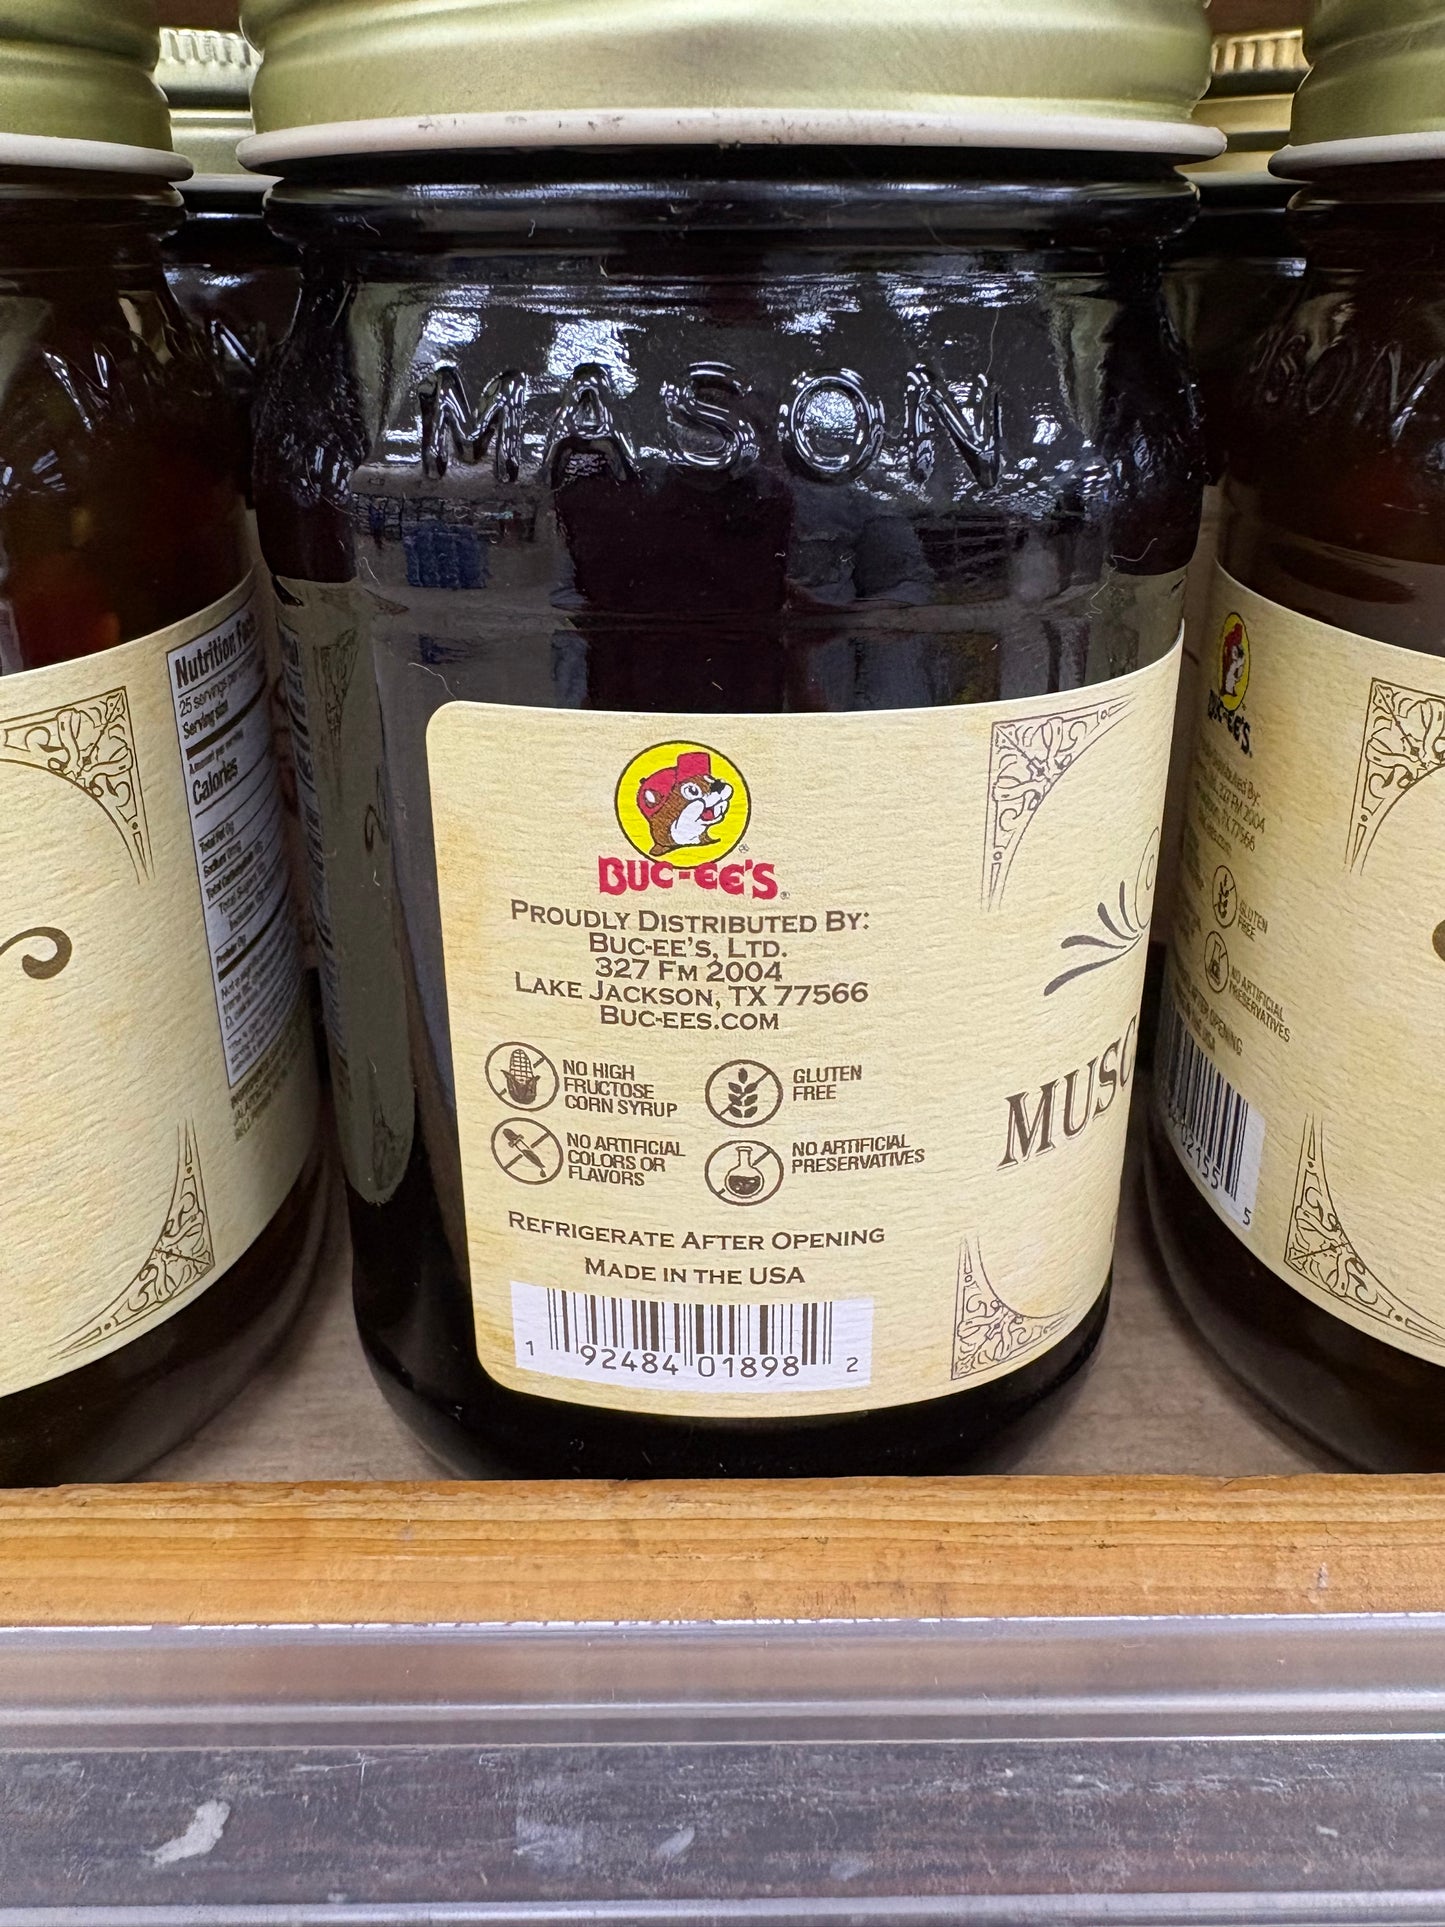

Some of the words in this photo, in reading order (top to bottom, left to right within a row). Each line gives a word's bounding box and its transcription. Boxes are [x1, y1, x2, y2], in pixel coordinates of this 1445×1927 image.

[418, 360, 1004, 489] MASON
[175, 632, 237, 689] Nutrition
[180, 696, 193, 718] 25
[192, 757, 239, 806] Calories
[597, 855, 779, 899] BUC-EE'S
[511, 899, 630, 931] PROUDLY
[638, 909, 817, 933] DISTRIBUTED
[826, 909, 870, 932] BY:
[1239, 900, 1269, 935] GLUTEN
[727, 938, 788, 959] LTD.
[595, 956, 650, 980] 327
[706, 961, 783, 982] 2004
[514, 971, 583, 1000] LAKE
[589, 980, 722, 1010] JACKSON,
[728, 985, 767, 1006] TX
[775, 981, 869, 1006] 77566
[1240, 976, 1285, 1023] ARTIFICIAL
[600, 1005, 780, 1031] BUC-EES.COM
[1228, 980, 1291, 1044] PRESERVATIVES
[563, 1060, 589, 1078] NO
[593, 1063, 635, 1082] HIGH
[792, 1065, 863, 1084] GLUTEN
[563, 1078, 655, 1101] FRUCTOSE
[792, 1084, 837, 1102] FREE
[565, 1096, 613, 1115] CORN
[616, 1099, 678, 1119] SYRUP
[566, 1133, 592, 1150] NO
[594, 1136, 687, 1158] ARTIFICIAL
[791, 1141, 818, 1158] NO
[820, 1134, 912, 1156] ARTIFICIAL
[567, 1150, 639, 1171] COLORS
[640, 1154, 666, 1173] OR
[791, 1149, 926, 1175] PRESERVATIVES
[568, 1166, 645, 1187] FLAVORS
[1243, 1206, 1252, 1226] 5
[508, 1210, 675, 1249] REFRIGERATE
[681, 1231, 765, 1251] AFTER
[771, 1228, 886, 1250] OPENING
[584, 1257, 657, 1282] MADE
[663, 1268, 687, 1284] IN
[690, 1268, 743, 1285] THE
[749, 1266, 806, 1285] USA
[525, 1341, 535, 1357] 1
[579, 1344, 679, 1376] 92484
[697, 1356, 800, 1378] 01898
[846, 1356, 859, 1373] 2
